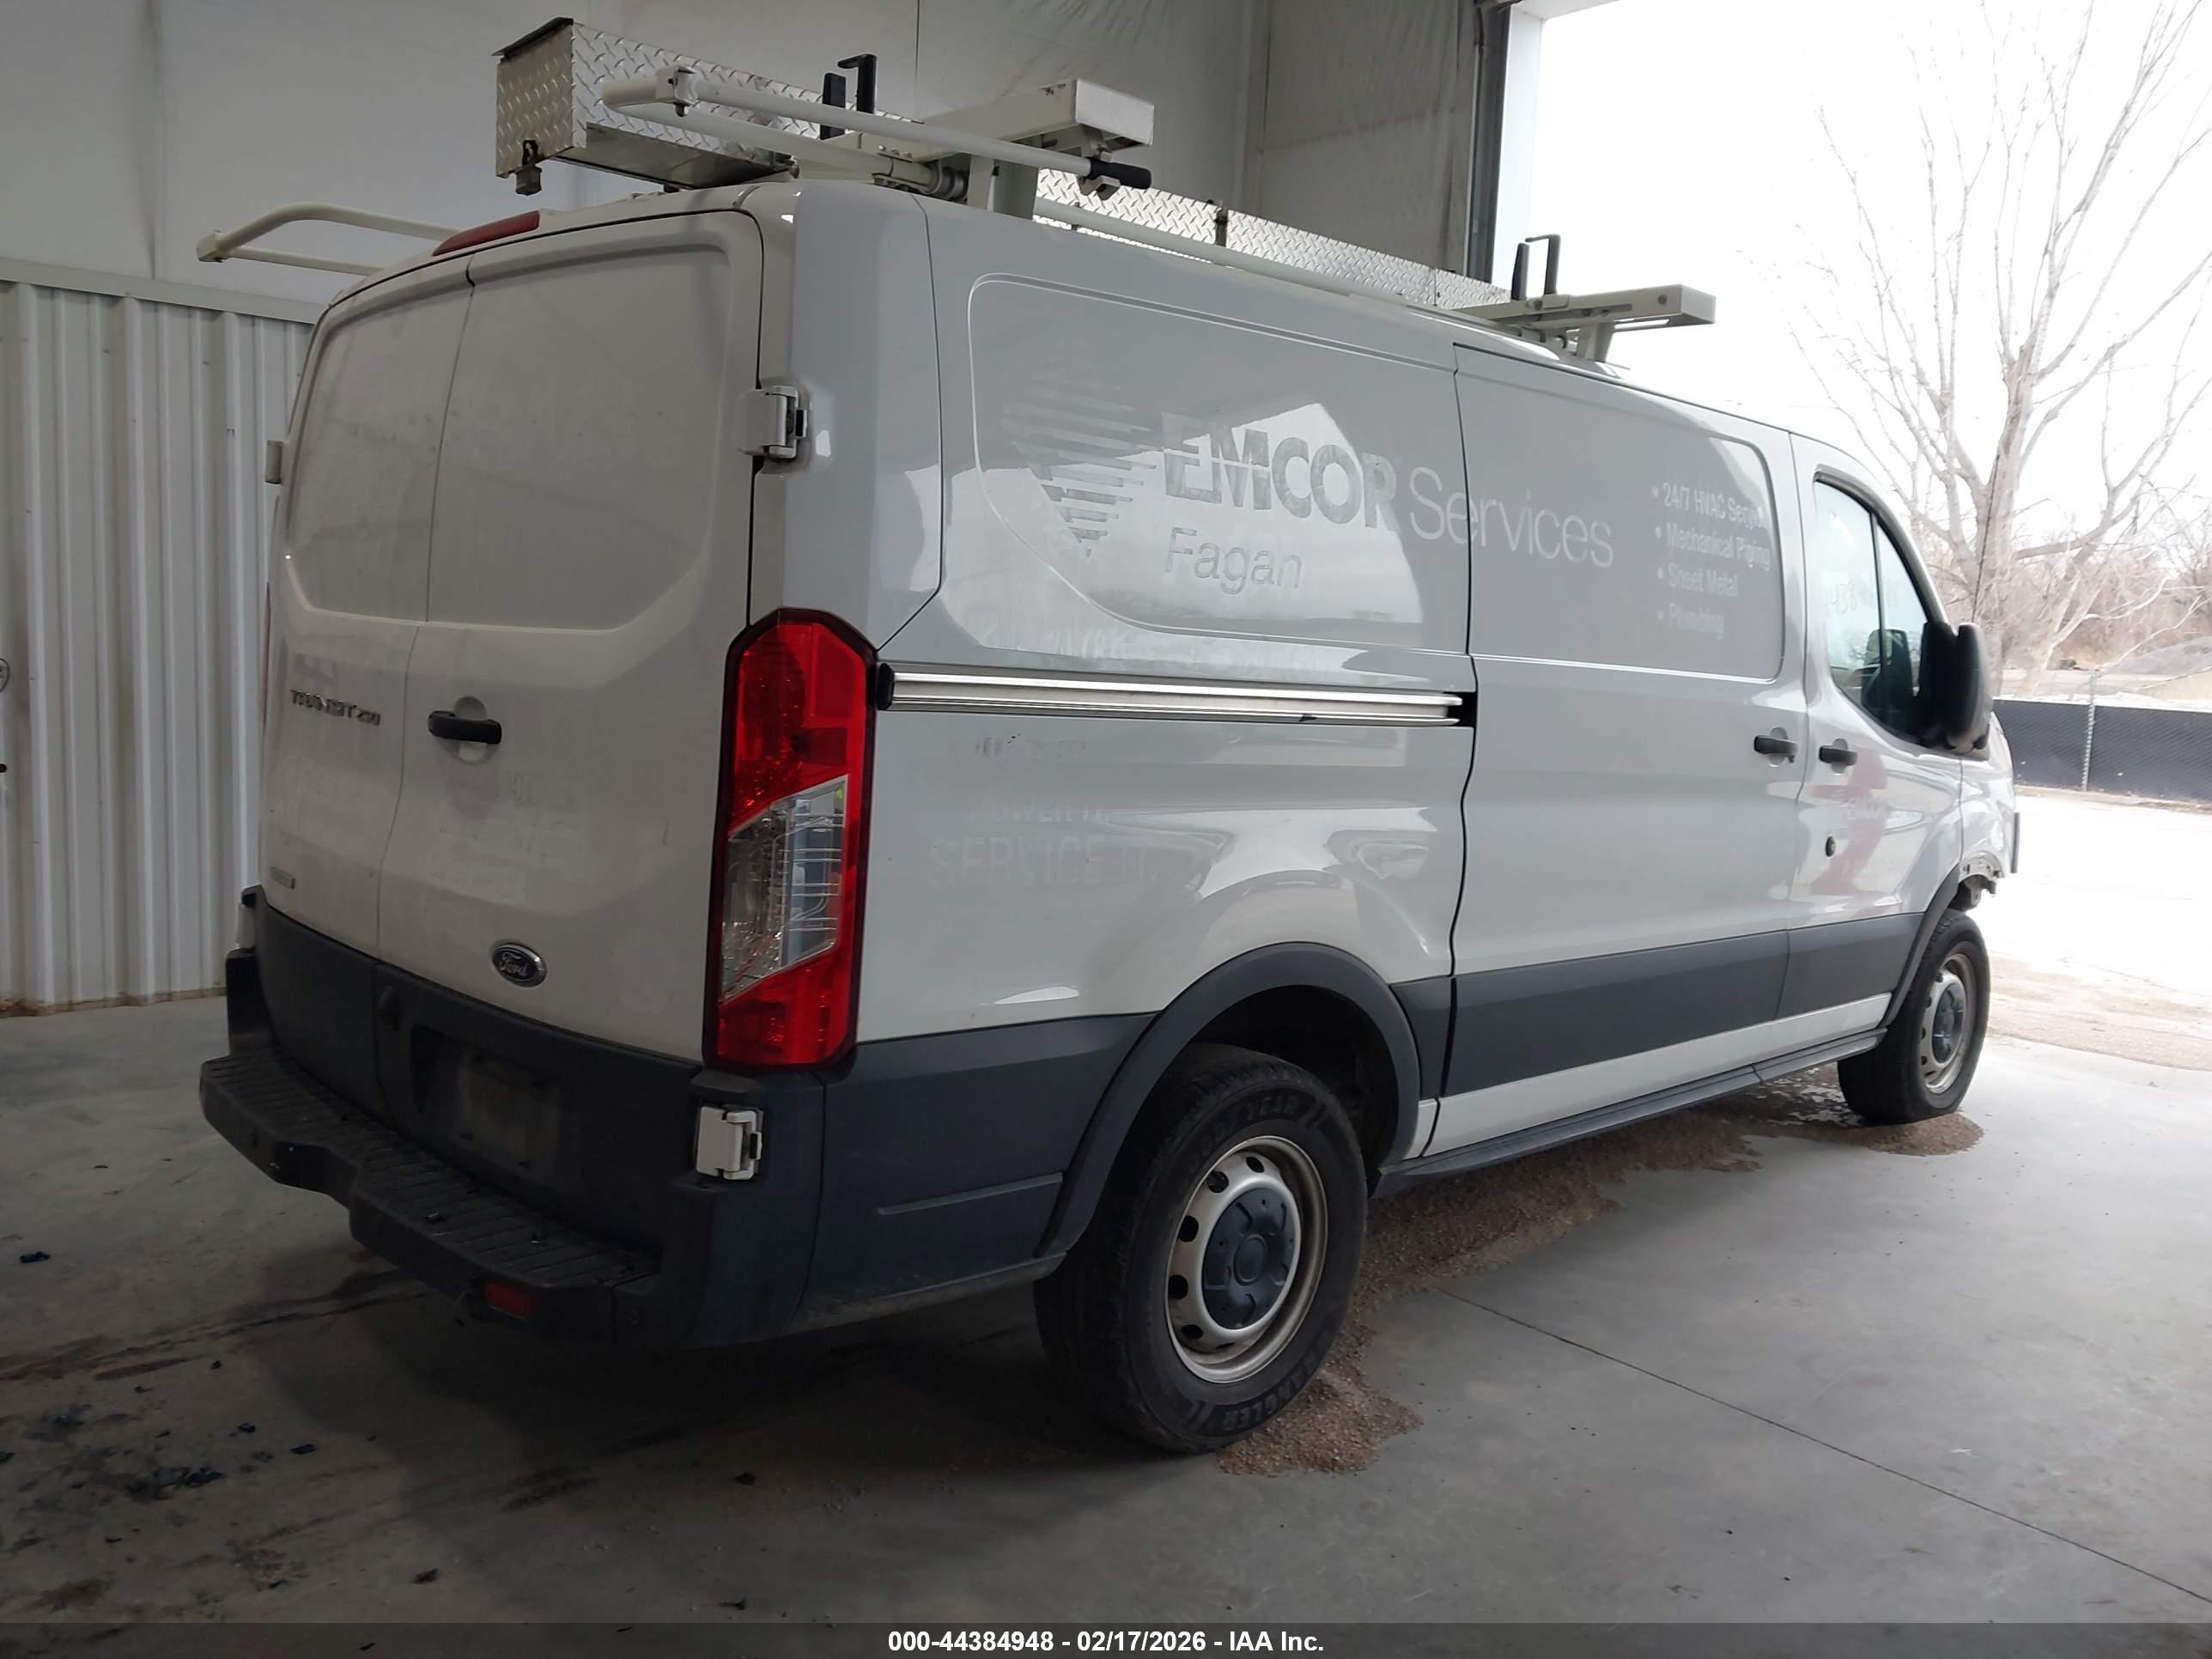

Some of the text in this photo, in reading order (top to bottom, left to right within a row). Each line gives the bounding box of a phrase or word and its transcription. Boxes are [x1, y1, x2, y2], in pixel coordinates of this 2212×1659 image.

[1160, 411, 1614, 568] EMCOR Services
[1662, 481, 1691, 512] 24/7
[1693, 489, 1726, 520] HVAC
[1164, 526, 1303, 595] Fagan
